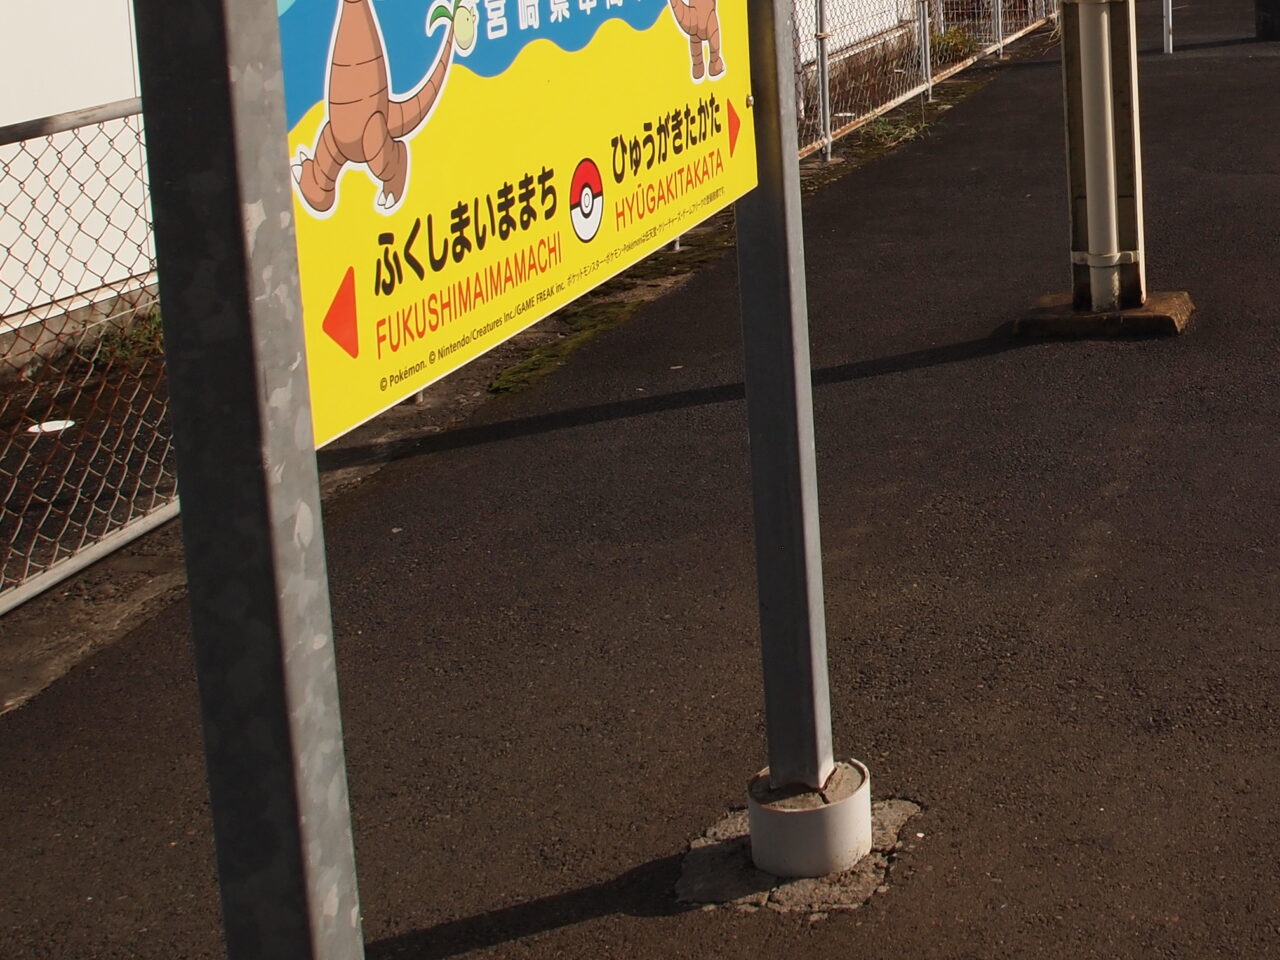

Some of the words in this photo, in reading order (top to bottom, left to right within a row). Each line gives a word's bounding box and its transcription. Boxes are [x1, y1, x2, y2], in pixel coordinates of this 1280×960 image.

[611, 90, 722, 185] ひゅうがきたかた
[374, 165, 558, 296] ふくしまいままち
[614, 148, 724, 232] HYŪGAKITAKATA
[376, 230, 562, 360] FUKUSHIMAIMAMACHI
[536, 285, 555, 303] FREAK
